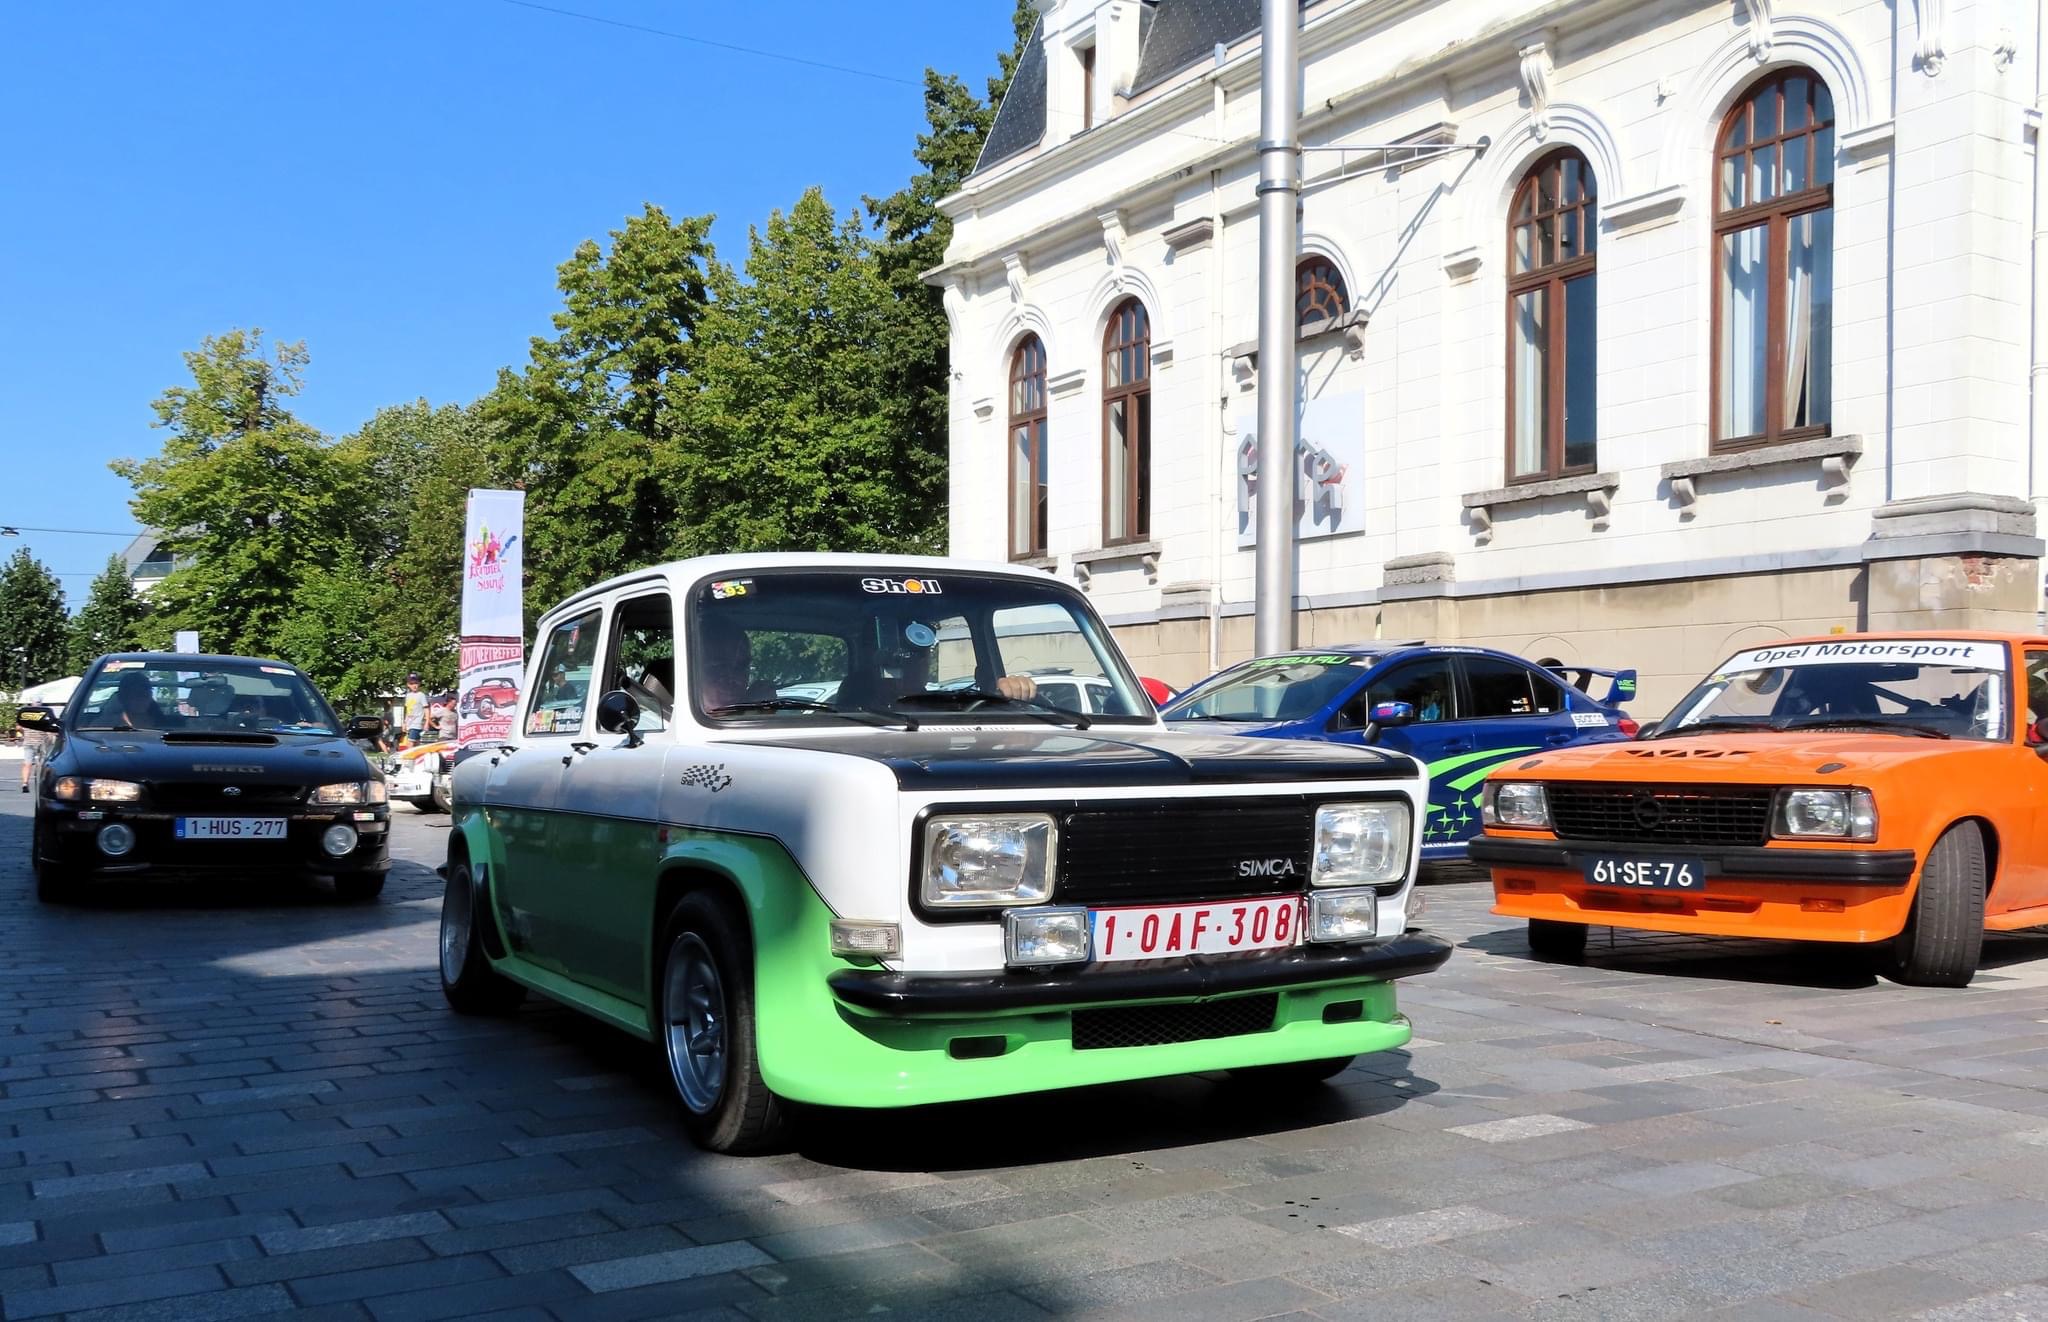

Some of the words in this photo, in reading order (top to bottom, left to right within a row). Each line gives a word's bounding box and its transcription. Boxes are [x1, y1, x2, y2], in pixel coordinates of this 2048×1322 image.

[725, 585, 747, 598] 93
[1250, 655, 1351, 668] SUBARU
[1753, 646, 1808, 663] Opel
[1815, 644, 1975, 658] Motorsport
[1239, 858, 1295, 877] SIMCA
